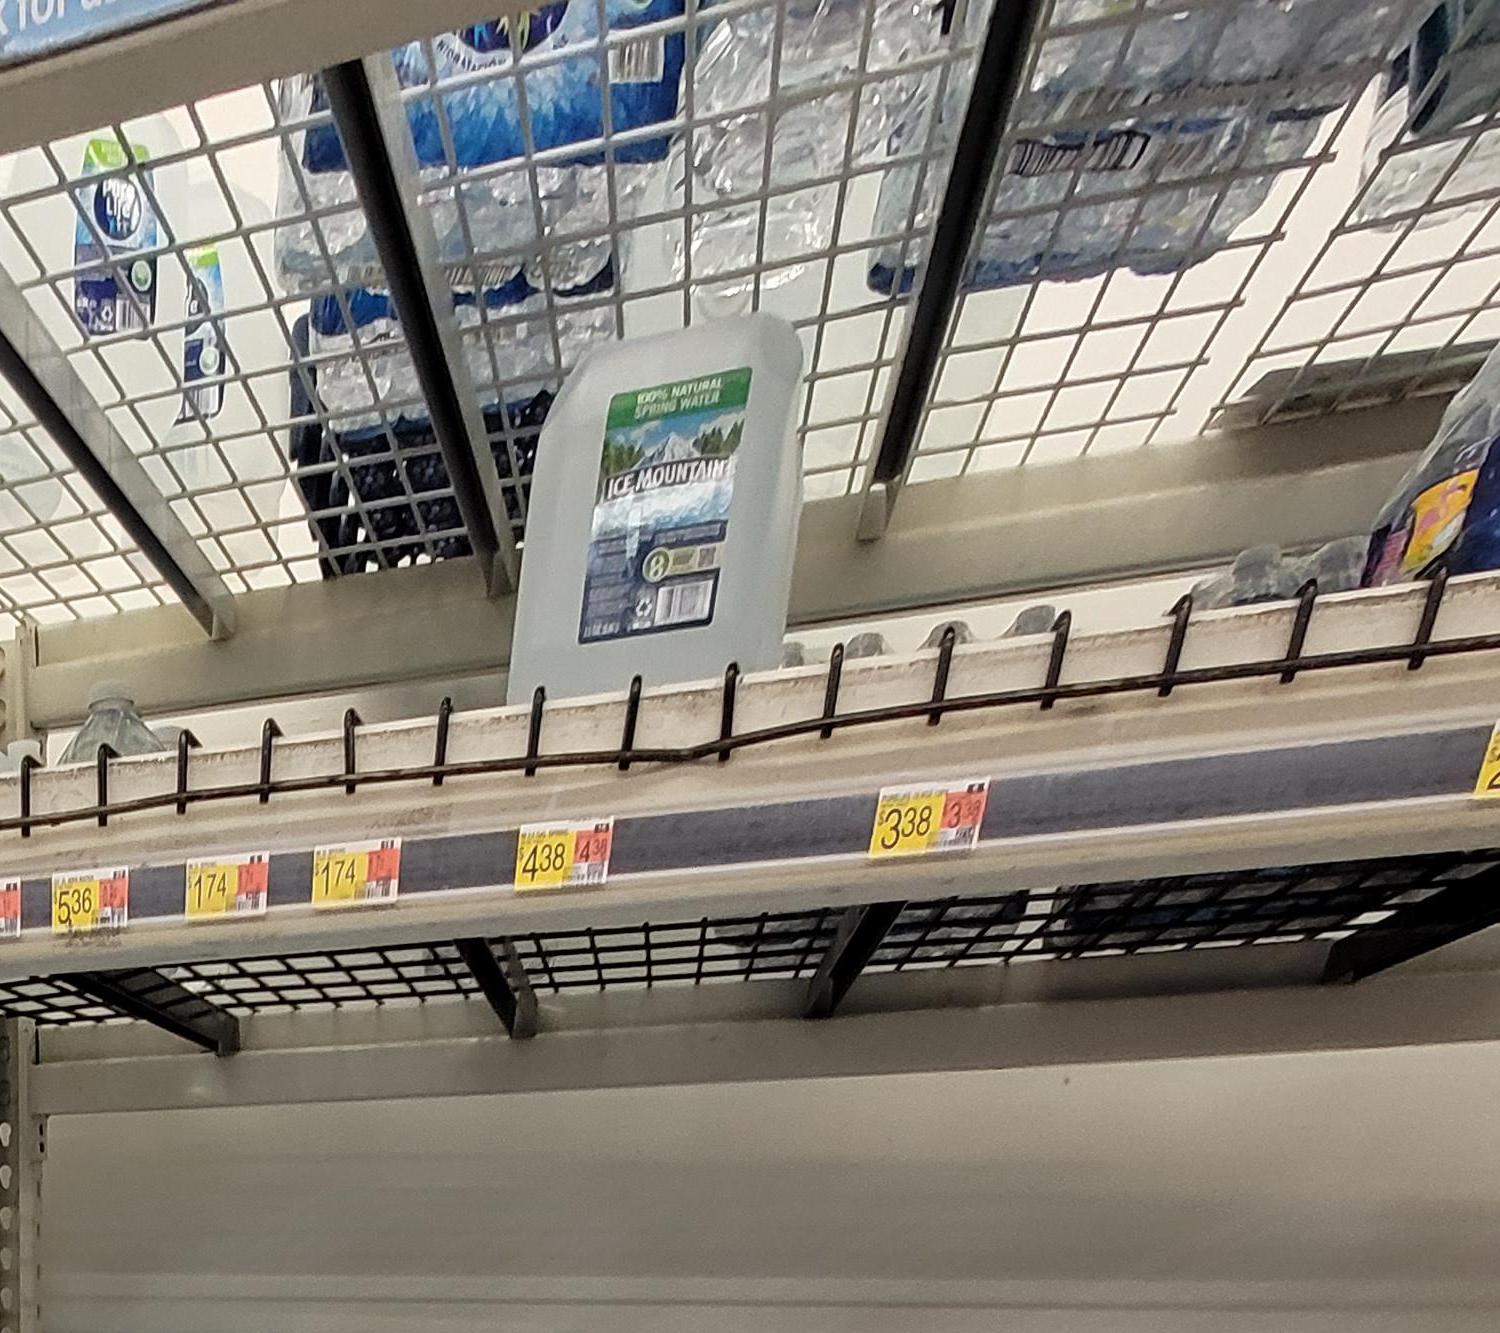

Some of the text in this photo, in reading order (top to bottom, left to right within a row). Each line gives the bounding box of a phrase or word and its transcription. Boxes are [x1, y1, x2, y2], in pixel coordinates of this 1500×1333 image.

[637, 377, 723, 404] 100% NATURAL
[634, 391, 720, 419] SPRING WATER
[608, 458, 728, 499] ICE MOUNTAIN
